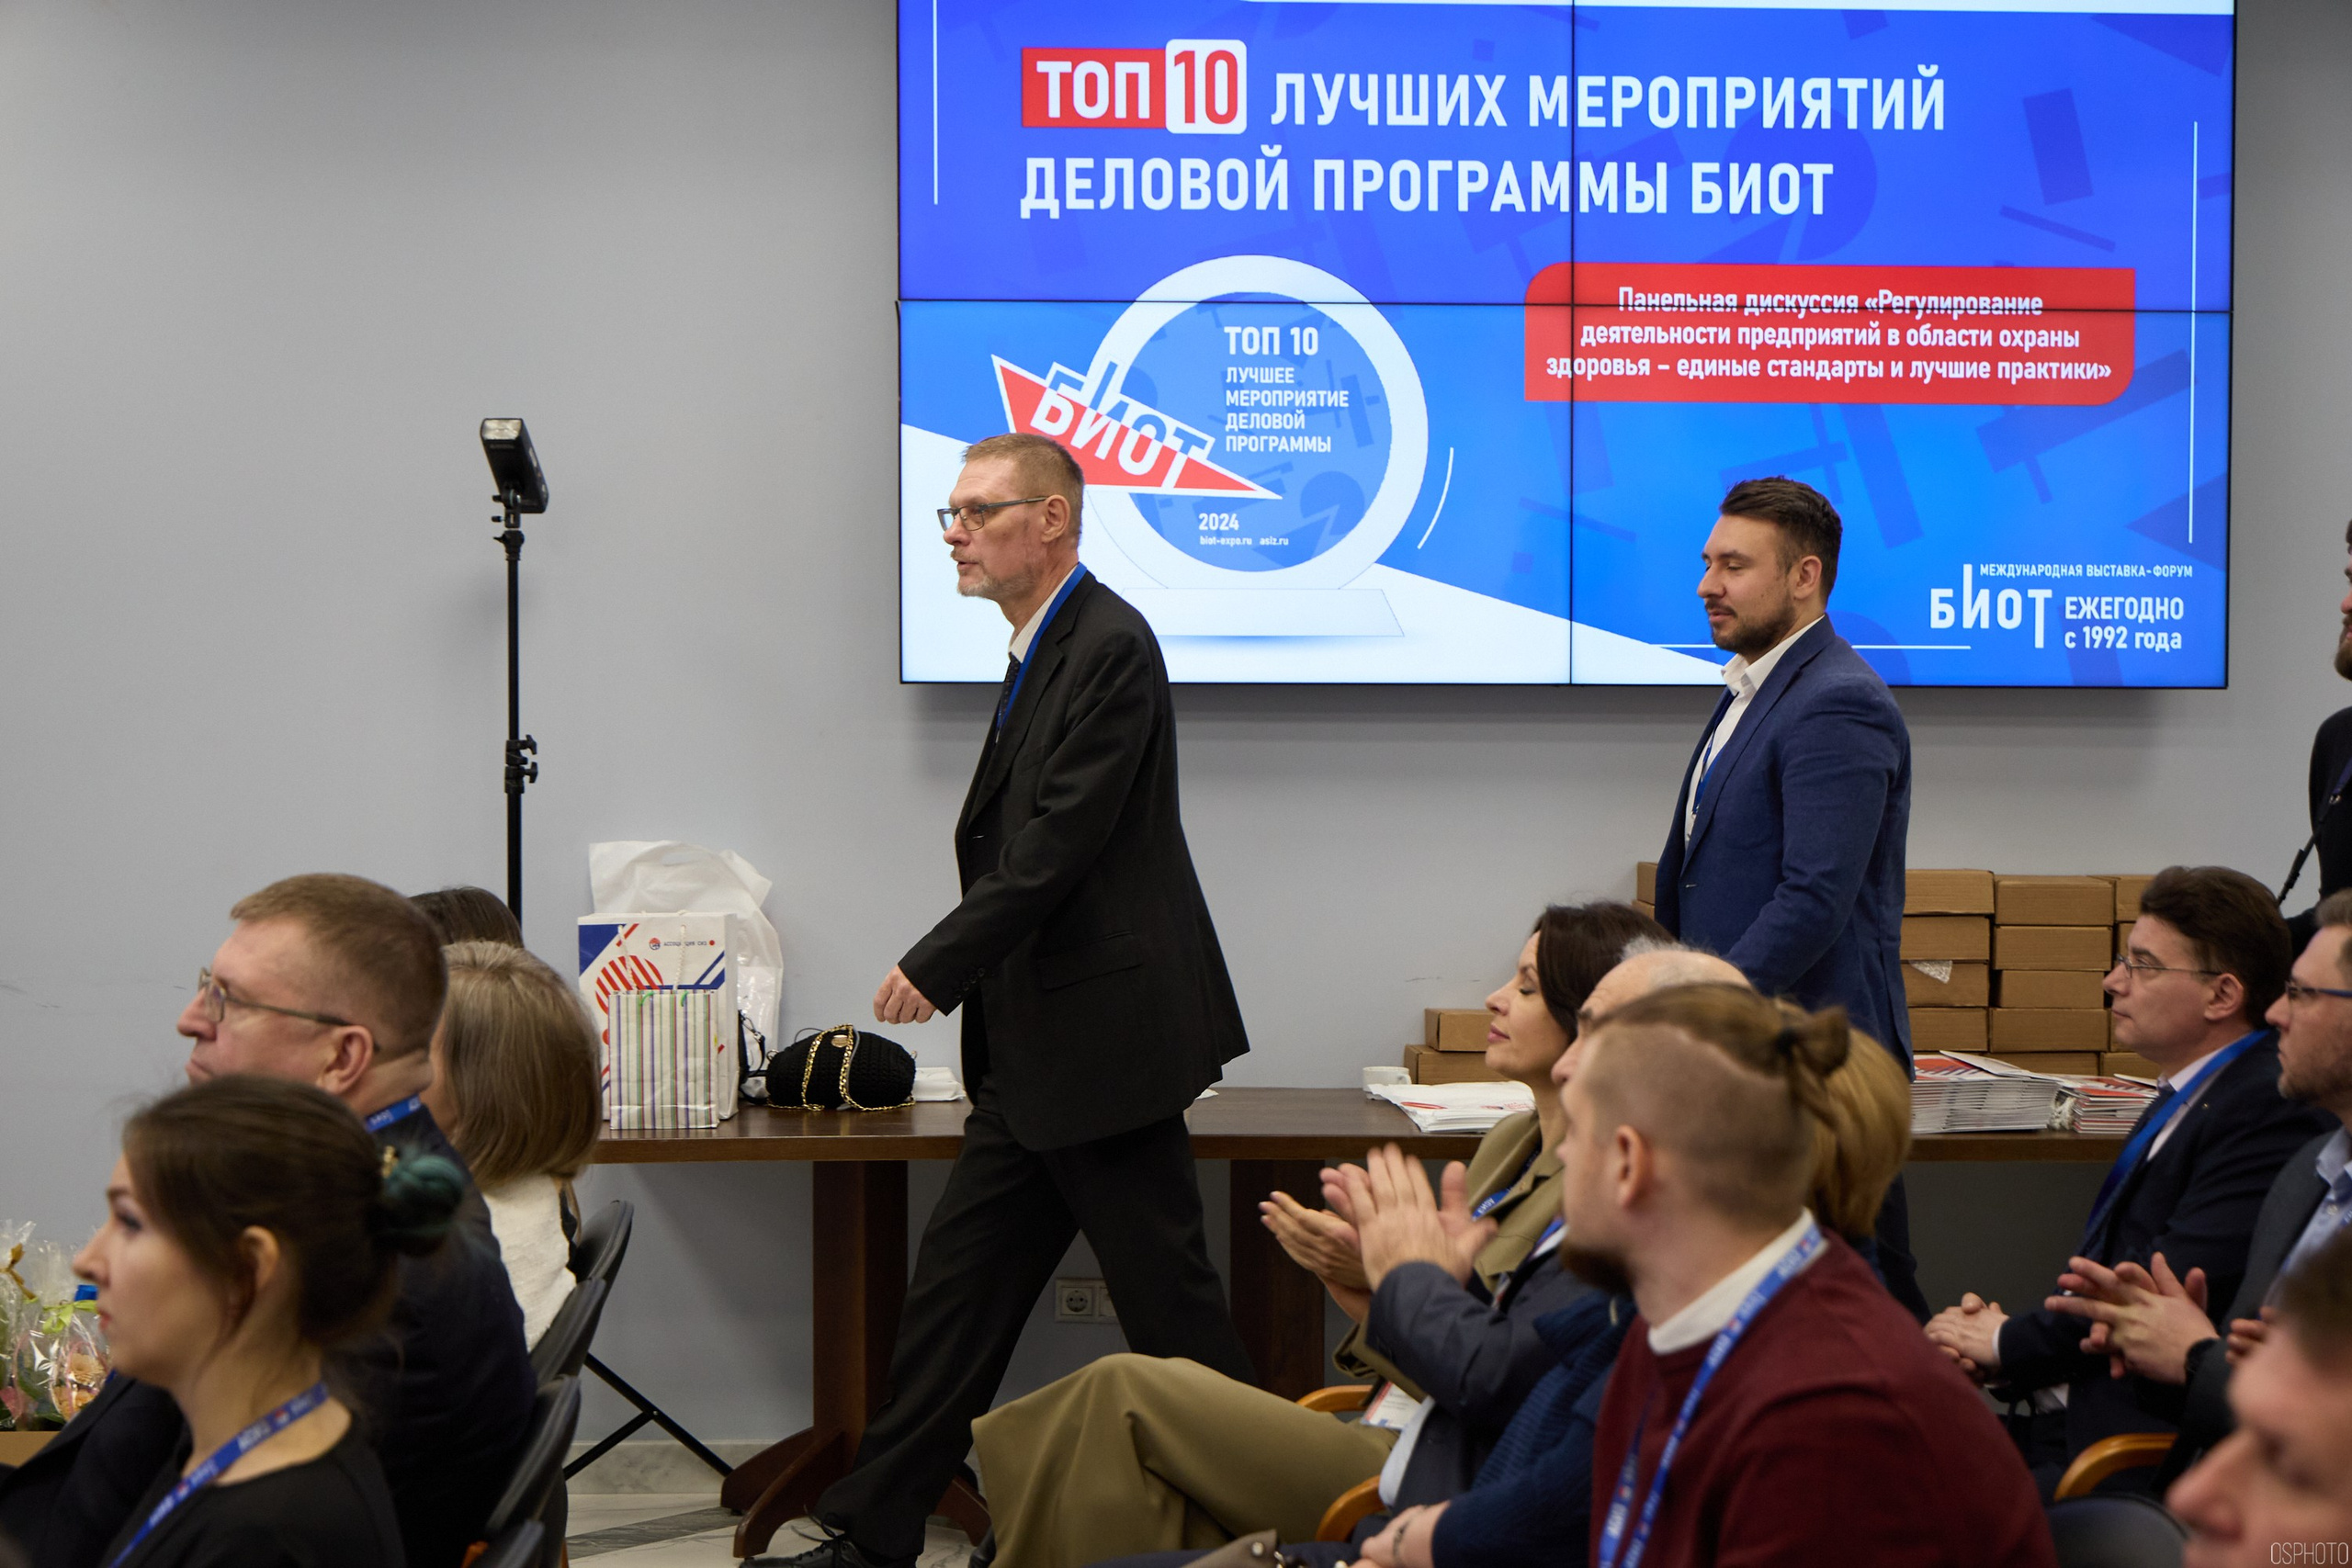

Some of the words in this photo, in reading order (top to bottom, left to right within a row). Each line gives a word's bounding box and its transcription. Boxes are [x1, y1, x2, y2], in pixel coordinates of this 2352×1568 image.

[1036, 61, 1149, 118] ТОП
[1174, 50, 1238, 125] 10
[1272, 73, 1507, 126] ЛУЧШИХ
[1529, 64, 1943, 130] МЕРОПРИЯТИЙ
[1020, 145, 1287, 219] ДЕЛОВОЙ
[1314, 160, 1667, 213] ПРОГРАММЫ
[1692, 163, 1833, 214] БИОТ
[1619, 287, 1737, 311] Панельная
[1743, 289, 1859, 318] дискуссия
[1865, 289, 2042, 318] «Регулирование
[1224, 325, 1280, 355] ТОП
[1291, 326, 1318, 355] 10
[1580, 325, 1730, 346] деятельности
[1737, 321, 1881, 350] предприятий
[1887, 329, 1900, 345] в
[1906, 322, 1992, 346] области
[1999, 330, 2079, 352] охраны
[1227, 367, 1294, 383] ЛУЧШЕЕ
[1546, 358, 1651, 381] здоровья
[1677, 359, 1760, 379] единые
[1767, 359, 1884, 383] стандарты
[1890, 361, 1904, 378] и
[1909, 361, 1991, 384] лучшие
[1998, 362, 2111, 384] практики»
[1227, 389, 1349, 407] МЕРОПРИЯТИЕ
[1030, 361, 1208, 489] БИОТ
[1226, 410, 1305, 432] ДЕЛОВОЙ
[1227, 435, 1330, 452] ПРОГРАММЫ
[1199, 513, 1238, 530] 2024
[1200, 536, 1252, 547] biot-expo.ru
[1260, 536, 1288, 545] asiz.ru
[1980, 564, 2082, 578] МЕЖДУНАРОДНАЯ
[2086, 564, 2192, 577] ВЫСТАВКА-ФОРУМ
[1929, 564, 2052, 649] БИОТ
[2064, 597, 2183, 623] ЕЖЕГОДНО
[2065, 633, 2075, 648] с
[2083, 626, 2127, 649] 1992
[2135, 632, 2181, 652] года
